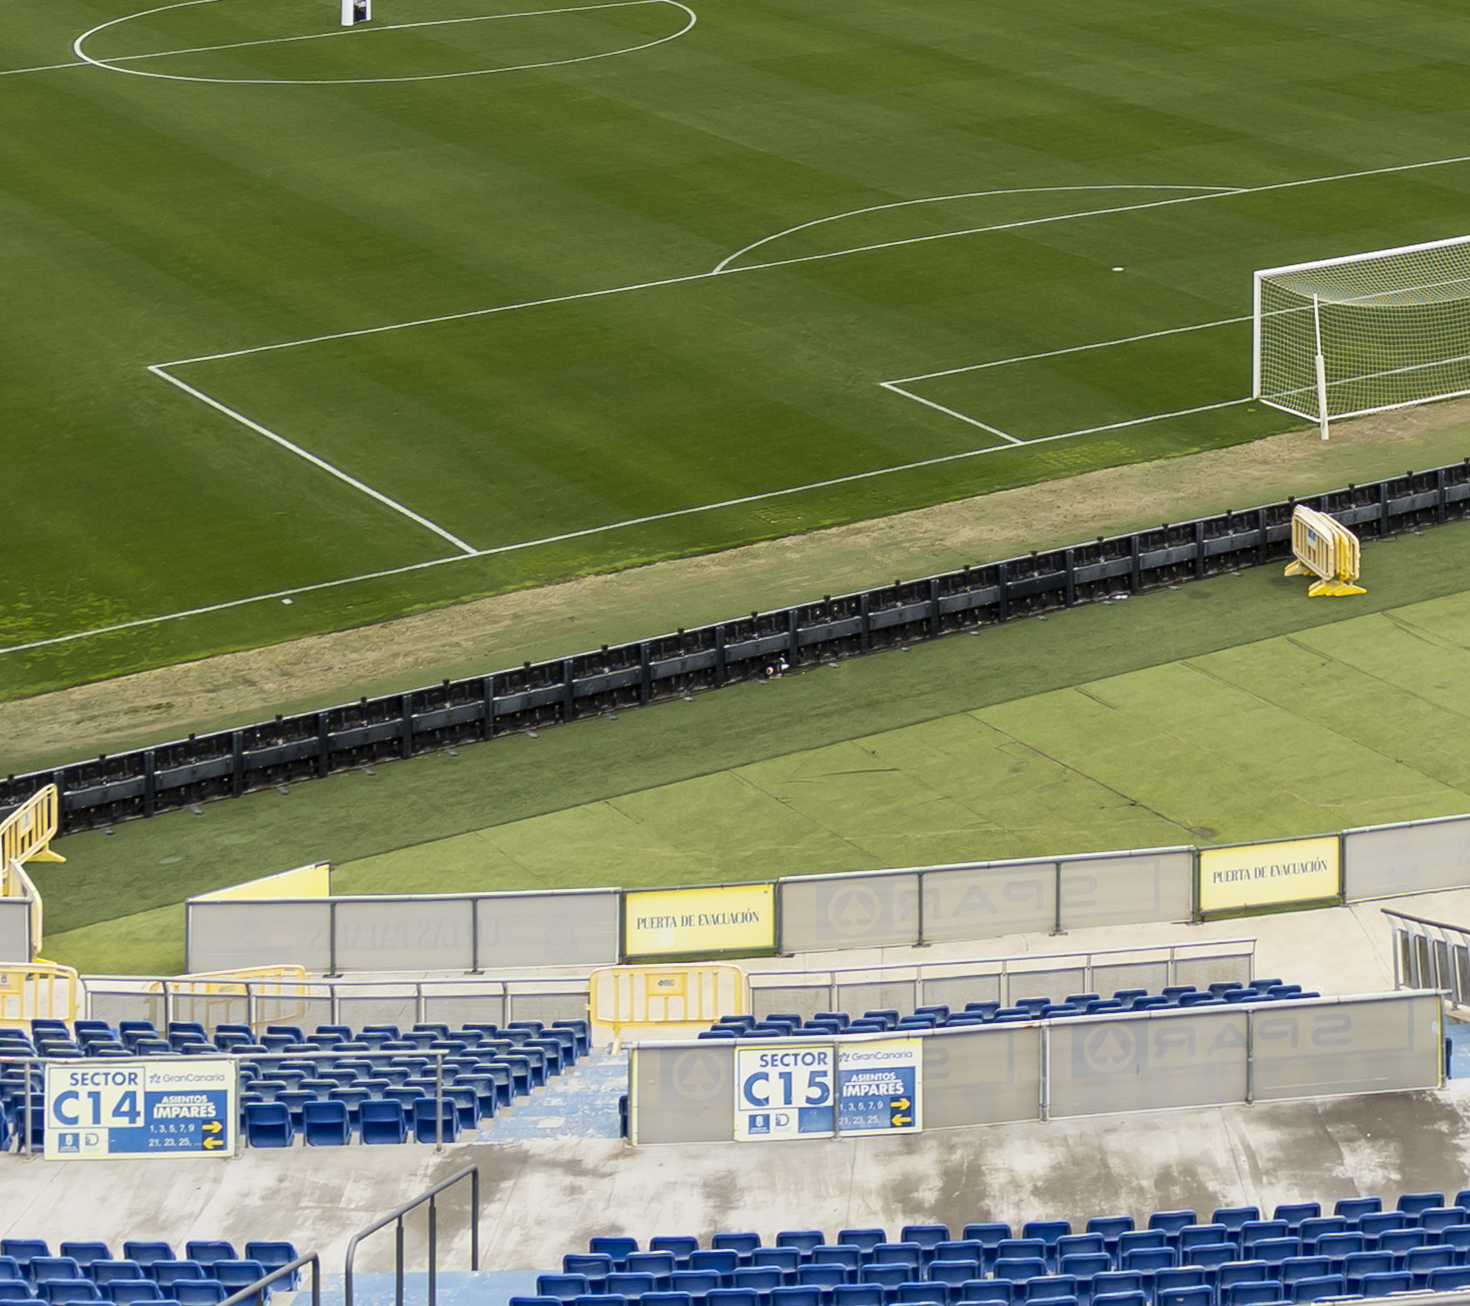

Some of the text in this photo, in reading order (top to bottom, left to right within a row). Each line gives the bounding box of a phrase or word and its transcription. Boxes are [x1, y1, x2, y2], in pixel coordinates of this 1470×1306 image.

[1213, 857, 1328, 884] PUERTA DE EVACUACIÓN
[637, 908, 759, 930] PUERTA DE EVACUACIÓN
[760, 1052, 828, 1068] SECTOR
[851, 1050, 913, 1062] GranCanaria
[70, 1072, 139, 1087] SECTOR
[162, 1074, 226, 1084] GranCanaria
[851, 1072, 896, 1084] ASIENTOS
[743, 1070, 830, 1106] C15
[842, 1082, 905, 1098] IMPARES
[53, 1090, 141, 1125] C14
[162, 1095, 207, 1106] ASIENTOS
[153, 1105, 217, 1119] IMPARES
